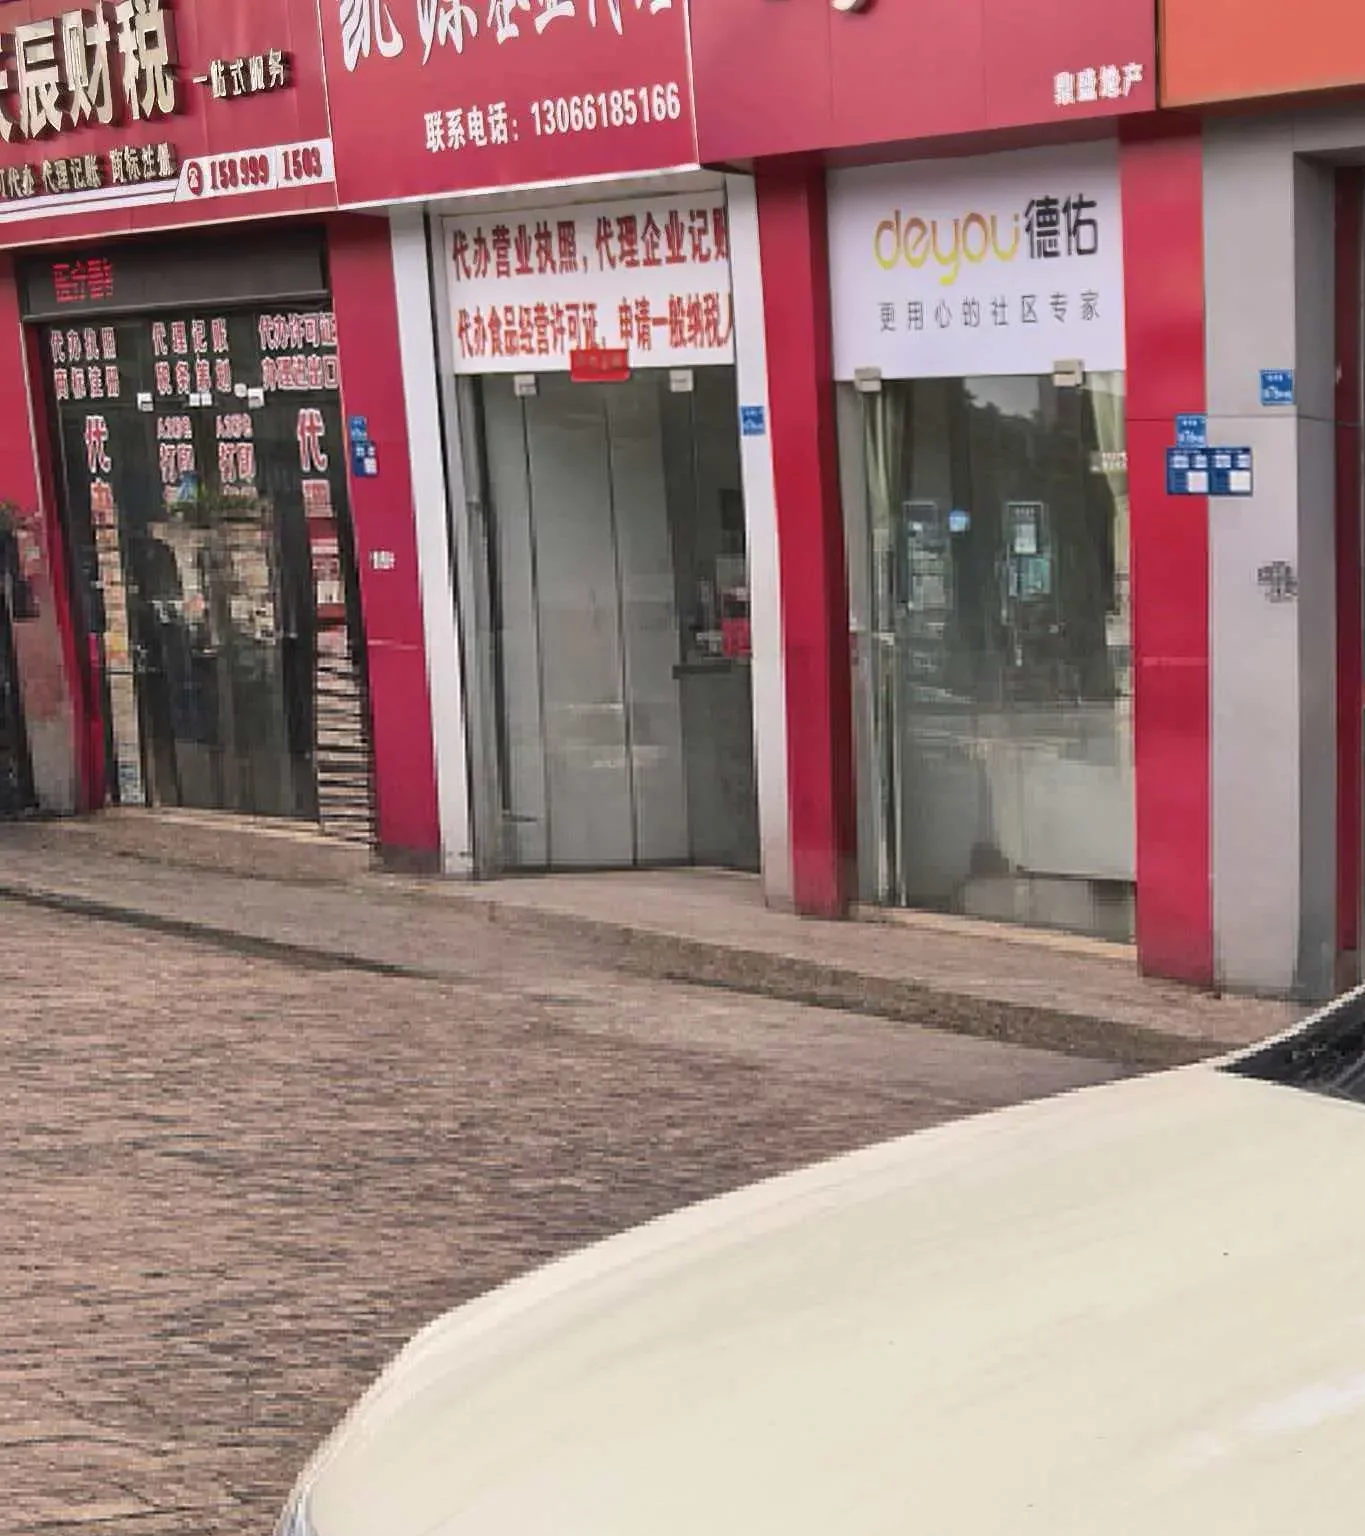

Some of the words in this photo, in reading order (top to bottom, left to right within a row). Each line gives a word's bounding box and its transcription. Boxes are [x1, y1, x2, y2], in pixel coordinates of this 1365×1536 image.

[0, 0, 176, 142] 辰财税
[193, 48, 286, 99] 一站式服务
[531, 83, 682, 135] 13066185166
[873, 209, 1021, 285] deyou
[1024, 193, 1099, 259] 德佑
[877, 289, 1101, 332] 更用心的社区专家
